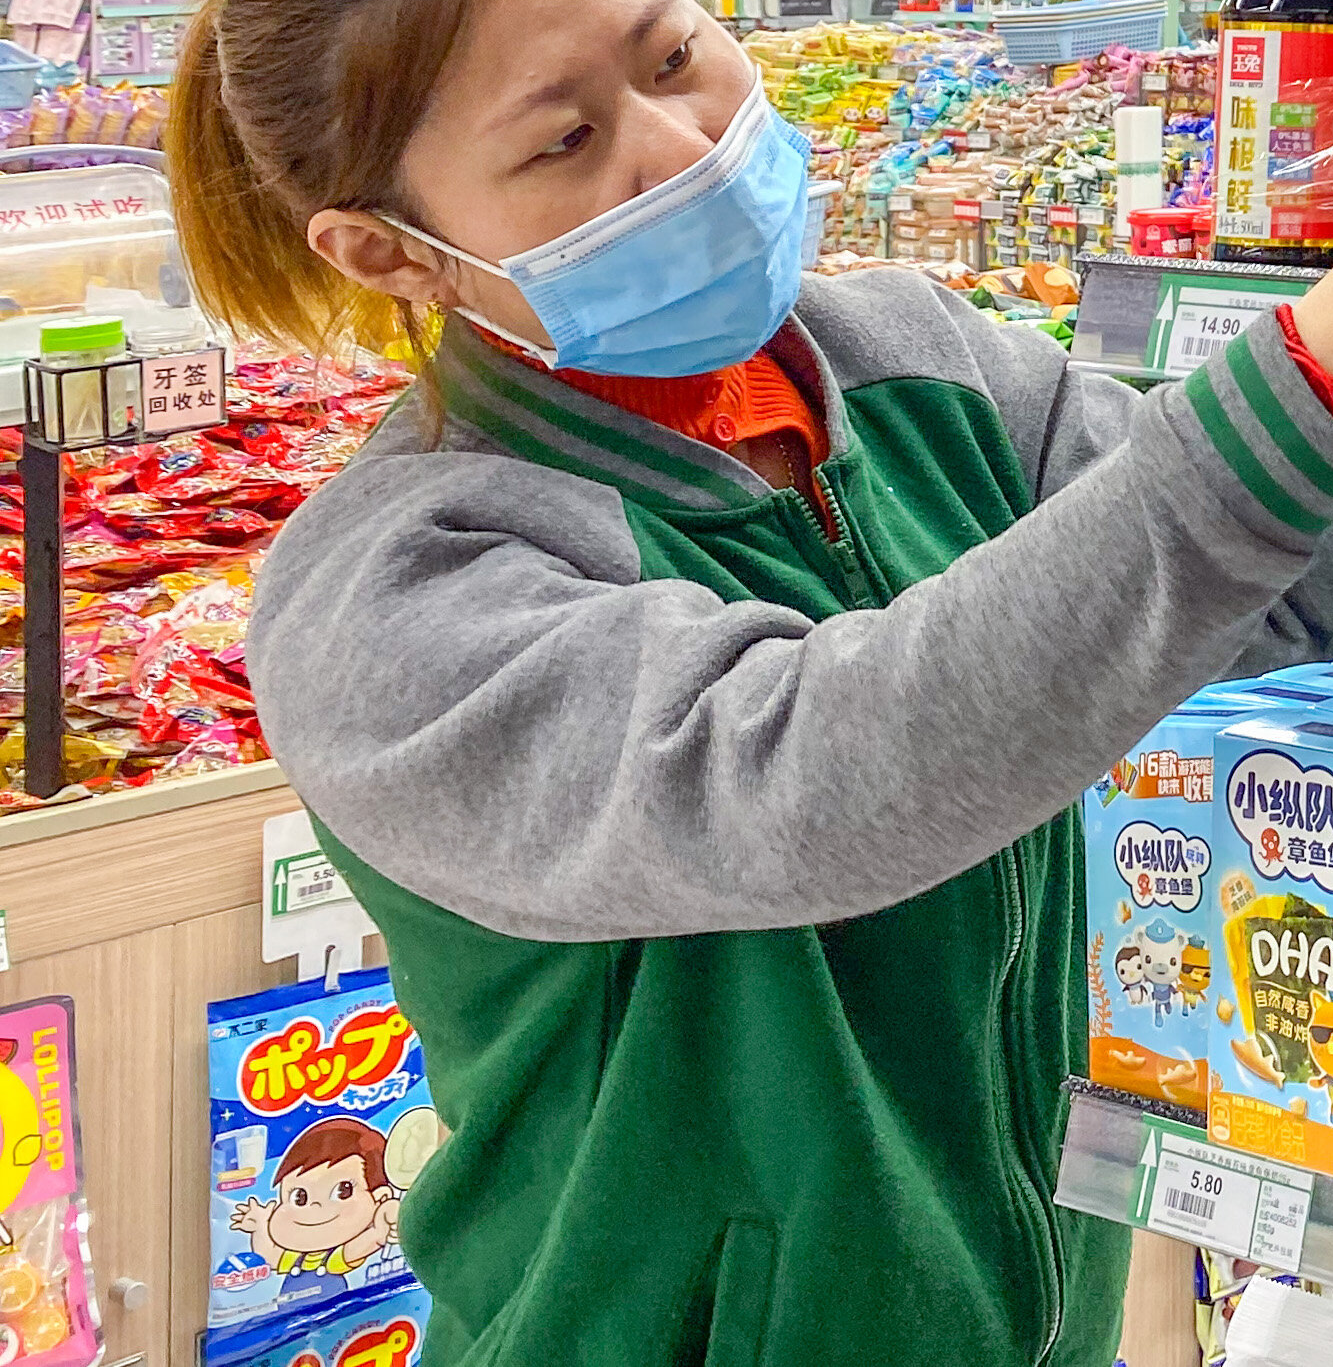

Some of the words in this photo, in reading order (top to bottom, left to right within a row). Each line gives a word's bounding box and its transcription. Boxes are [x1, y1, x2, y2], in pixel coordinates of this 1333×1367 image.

[0, 195, 144, 230] 欢迎试吃
[1200, 316, 1241, 335] 14.90
[153, 363, 208, 390] 牙签
[149, 389, 217, 415] 回收处
[1119, 836, 1189, 874] 小纵队
[1154, 876, 1194, 897] 章鱼堡
[1254, 988, 1310, 1019] 自然咸香
[1265, 1013, 1310, 1043] 非油炸
[249, 1014, 409, 1101] ポップ
[32, 1025, 65, 1173] LOLLIPOP
[342, 1076, 407, 1108] キャンディ
[1189, 1169, 1224, 1196] 5.80
